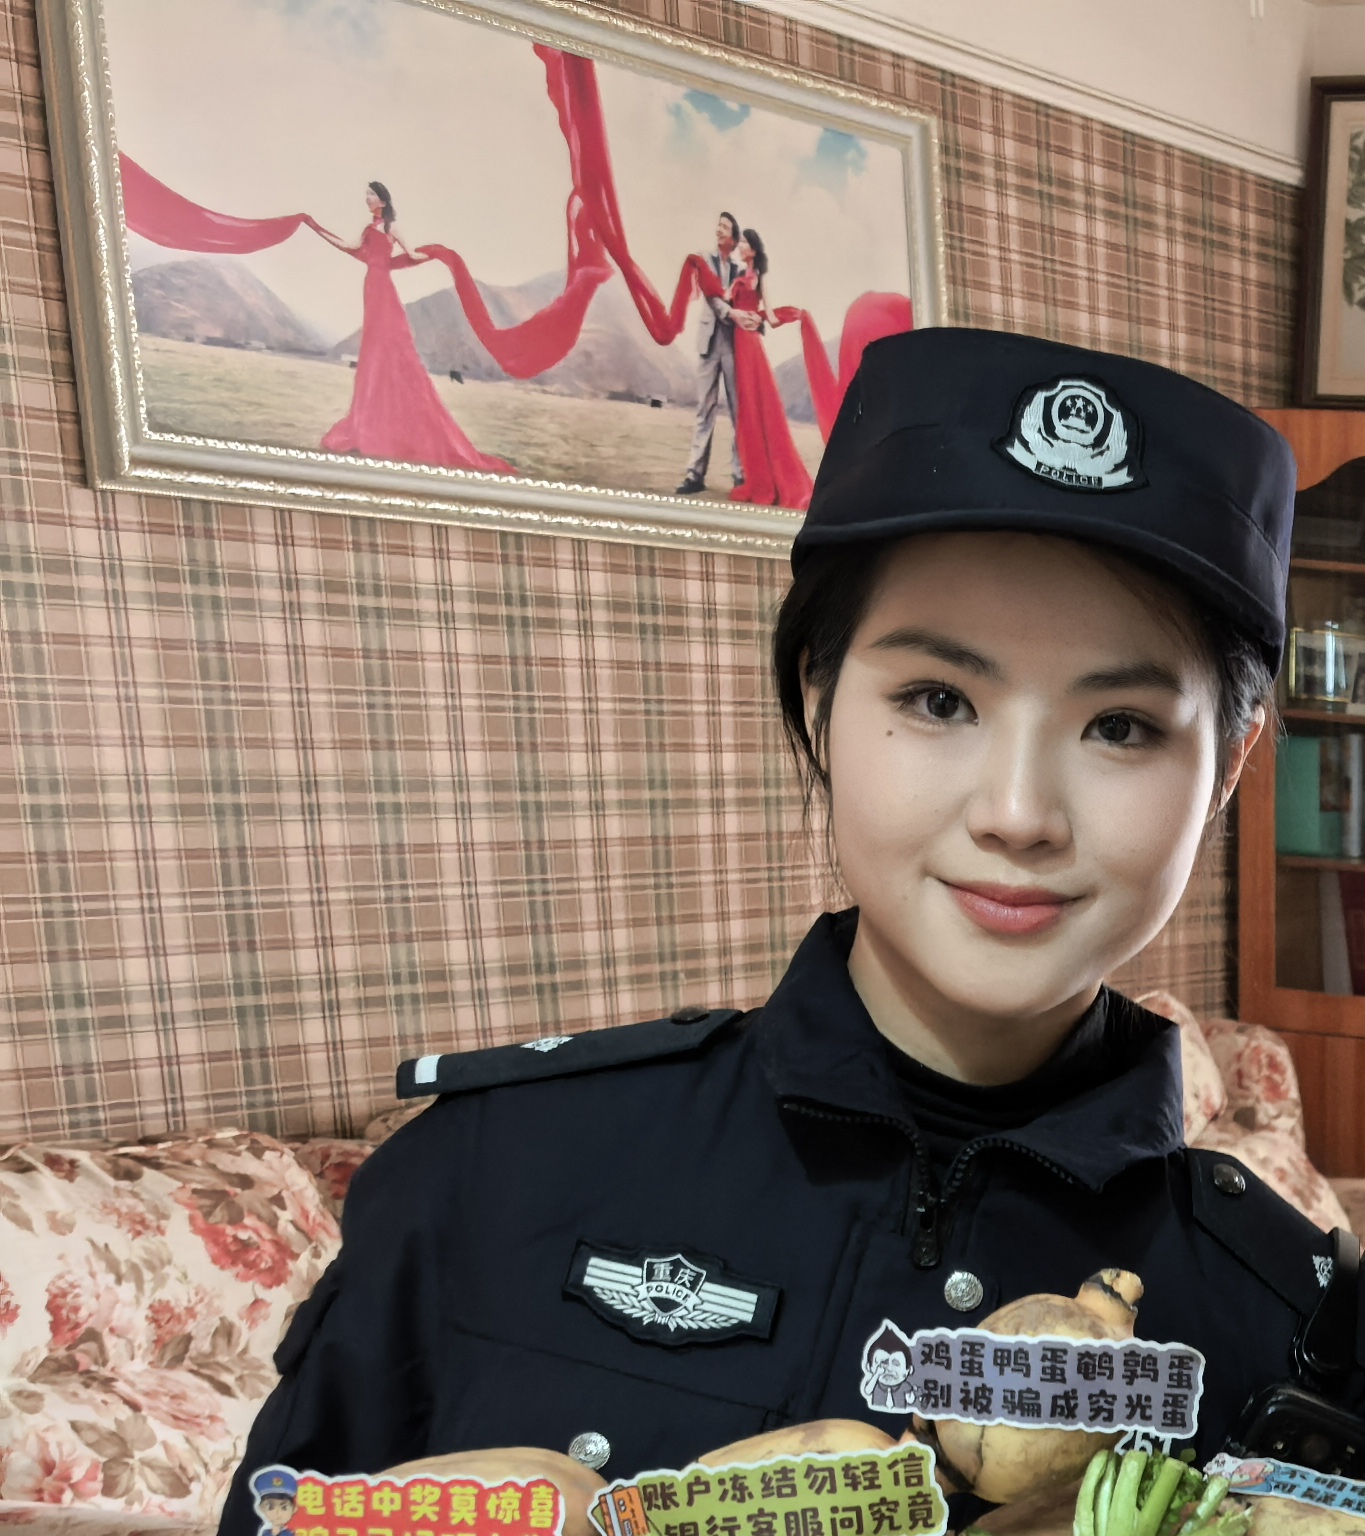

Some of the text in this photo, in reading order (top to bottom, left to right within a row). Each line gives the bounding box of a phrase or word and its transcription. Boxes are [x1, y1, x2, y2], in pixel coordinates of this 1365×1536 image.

[646, 1284, 691, 1304] POLICE
[652, 1261, 697, 1288] 重庆
[920, 1341, 1194, 1390] 鸡蛋鸭蛋鹌鹑蛋
[919, 1379, 1189, 1429] 别被骗成穷光蛋
[296, 1483, 555, 1527] 电话中奖莫惊喜
[643, 1453, 925, 1512] 账户冻结勿轻信
